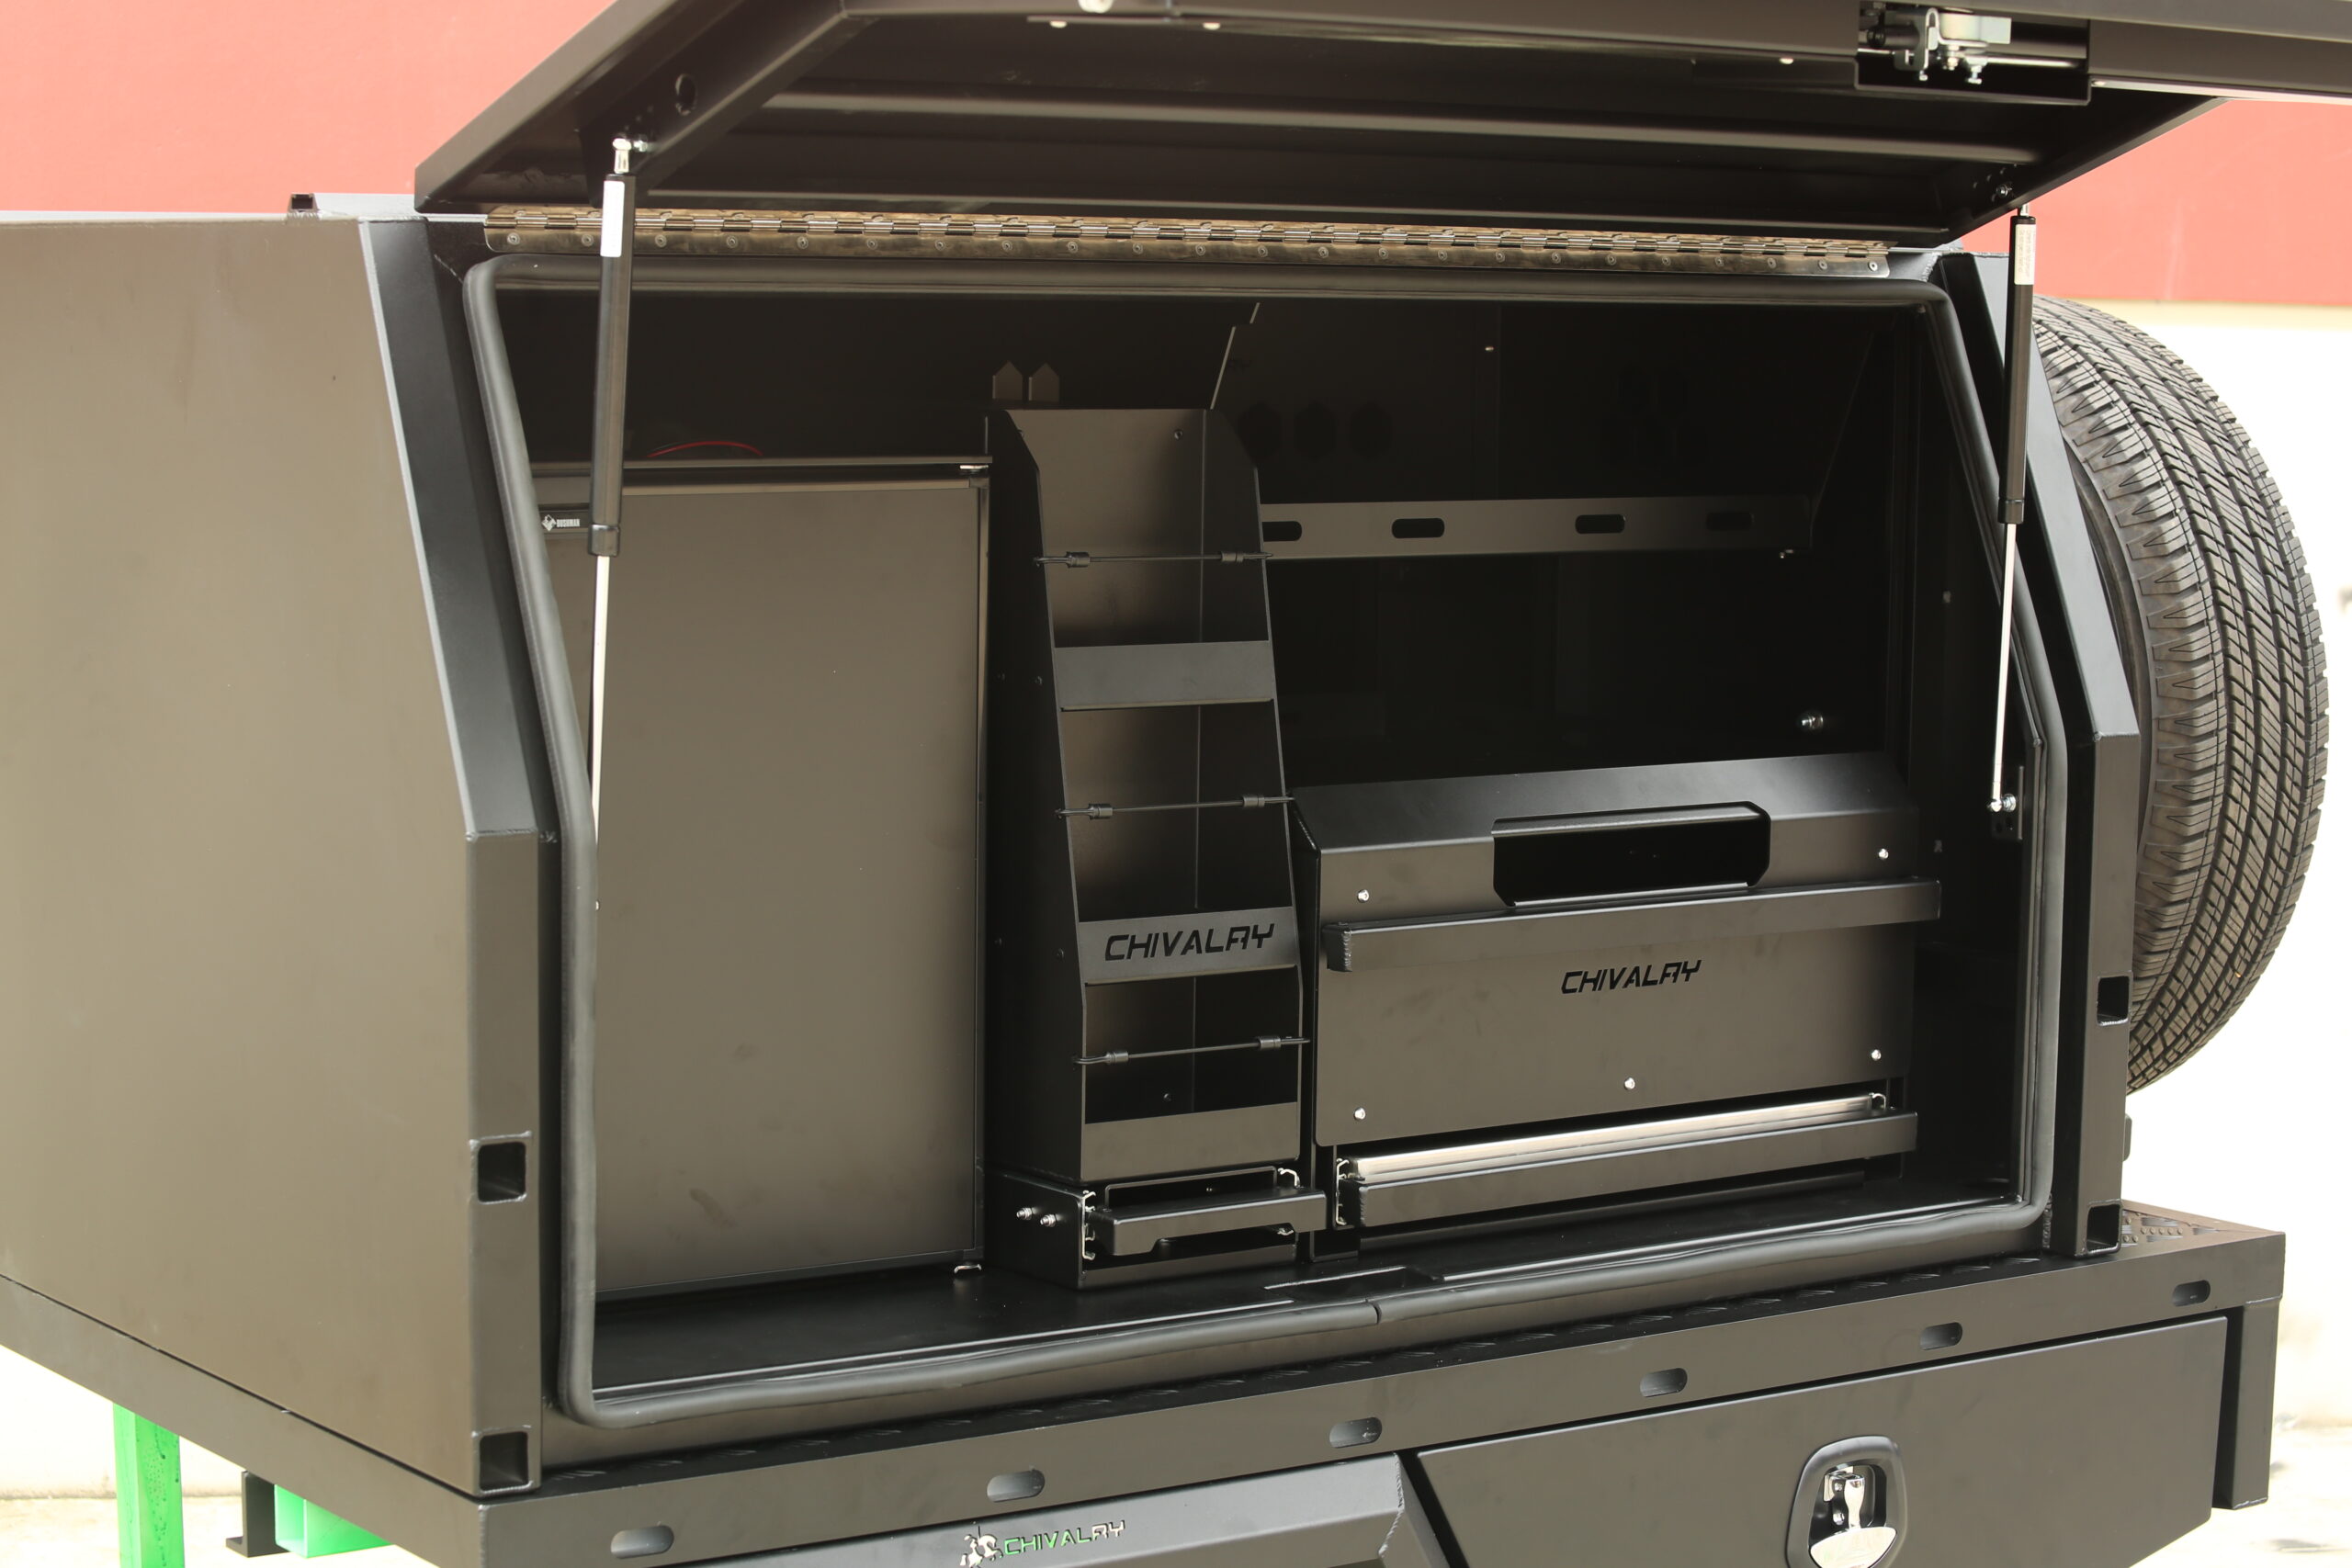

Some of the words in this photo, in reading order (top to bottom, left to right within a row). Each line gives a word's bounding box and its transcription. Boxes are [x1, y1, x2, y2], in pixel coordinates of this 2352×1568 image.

[1104, 923, 1275, 961] CHIVALRY
[1561, 960, 1702, 994] CHIVALRY
[1004, 1519, 1125, 1555] CHIVALRY
